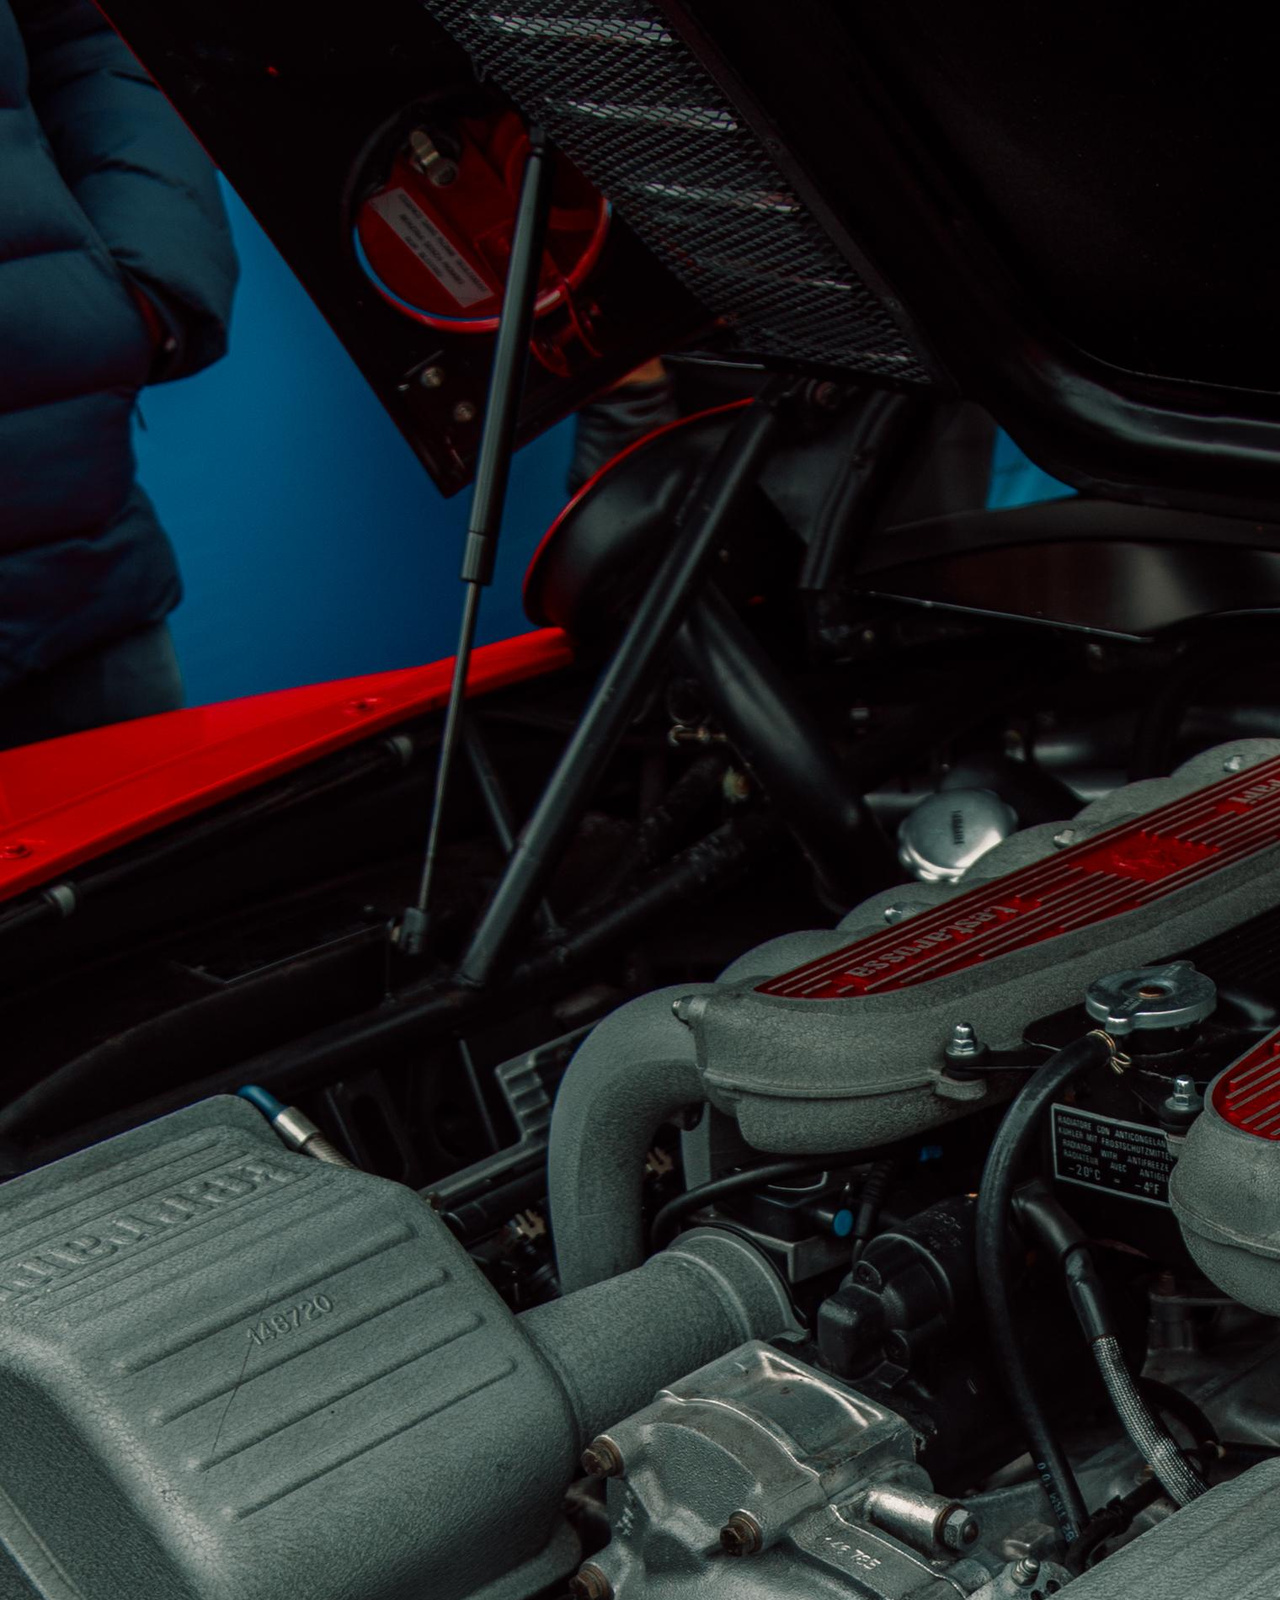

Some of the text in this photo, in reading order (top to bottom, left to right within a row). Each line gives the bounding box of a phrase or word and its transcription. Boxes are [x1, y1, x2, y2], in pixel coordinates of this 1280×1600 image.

[1100, 1149, 1118, 1160] WITH
[1127, 1155, 1170, 1172] ANTIFREEZE
[1109, 1161, 1128, 1173] AVEC
[0, 1158, 308, 1302] Ferrar
[247, 1293, 333, 1346] 148720
